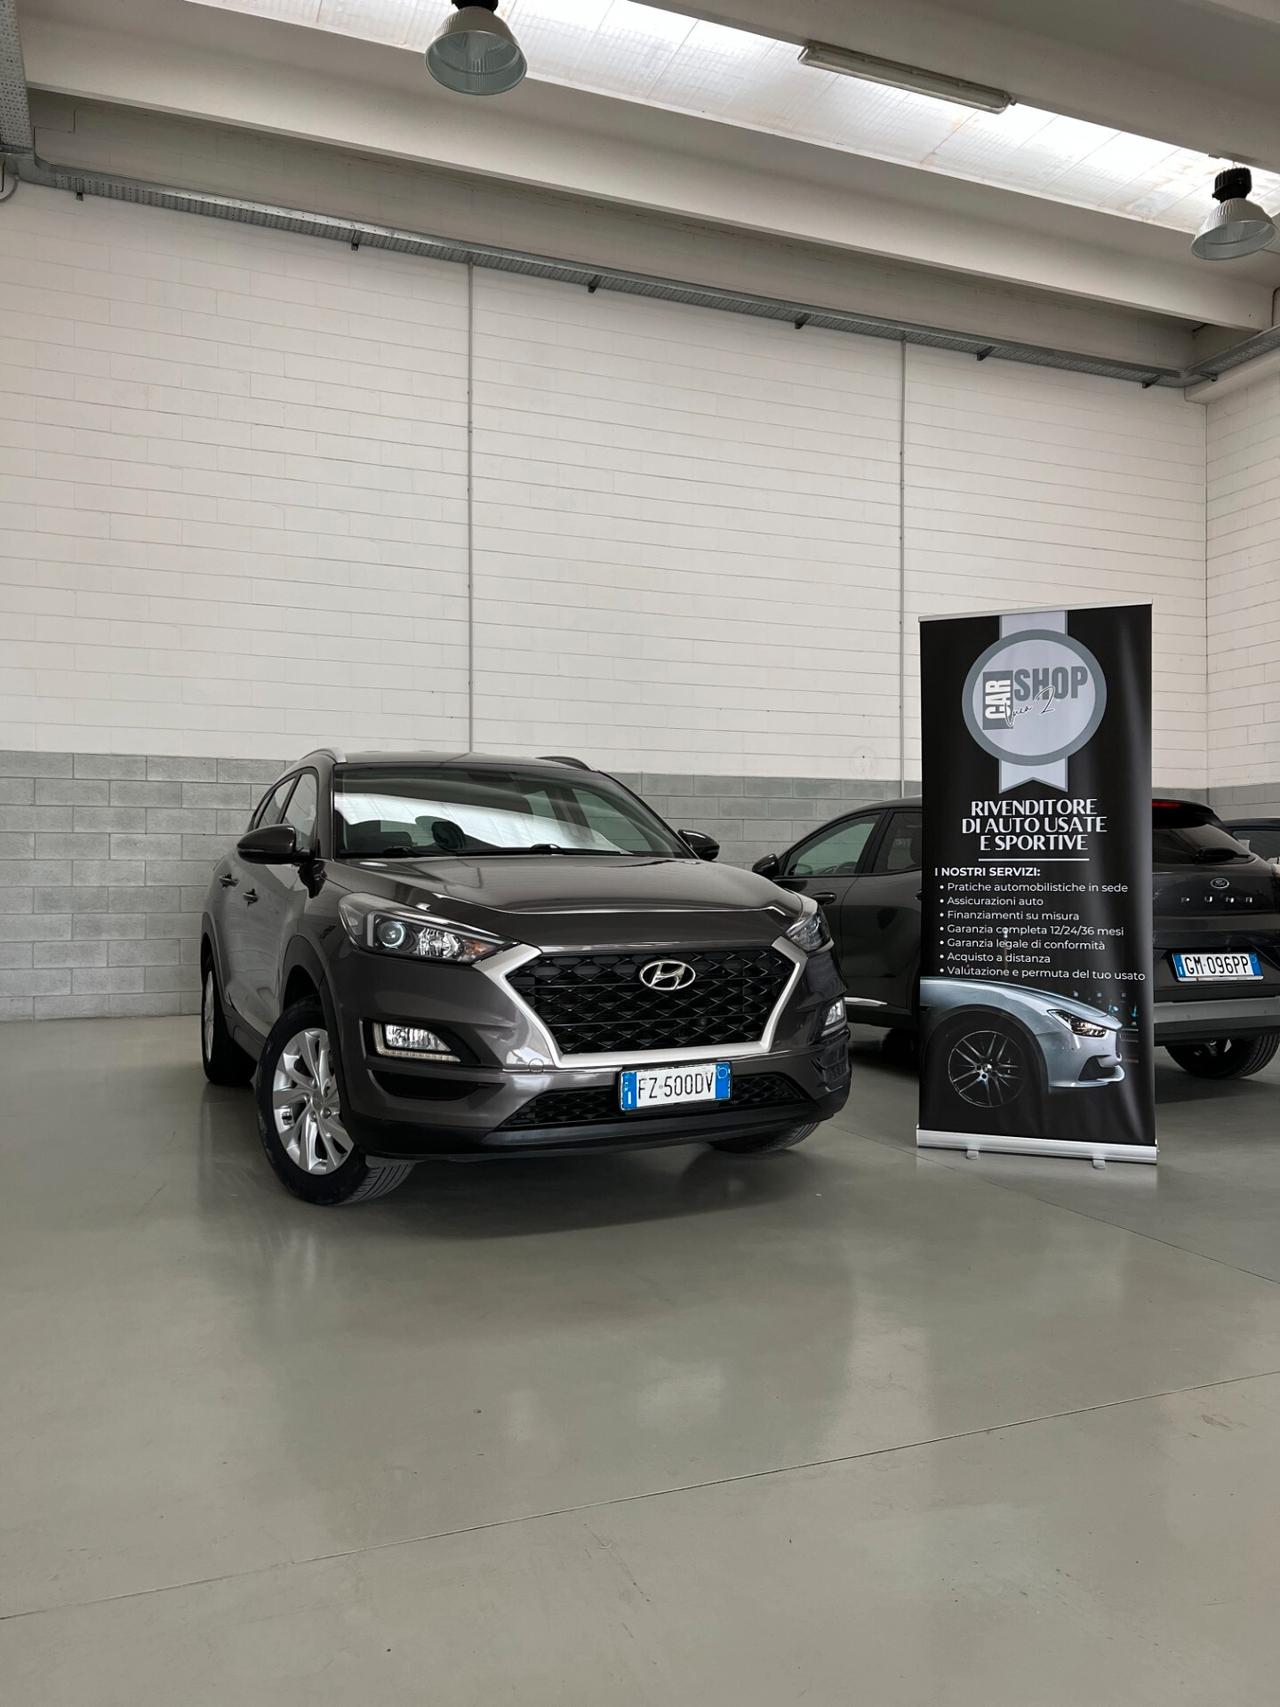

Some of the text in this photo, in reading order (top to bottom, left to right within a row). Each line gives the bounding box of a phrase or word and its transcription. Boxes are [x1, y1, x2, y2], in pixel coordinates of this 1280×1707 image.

[1013, 666, 1088, 701] SHOP
[984, 679, 1011, 720] CAR
[971, 799, 1098, 816] RIVENDITORE
[962, 816, 1108, 834] DI AUTO USATE
[980, 834, 1089, 851] E SPORTIVE
[941, 867, 986, 877] NOSTRI
[989, 867, 1041, 877] SERVIZI:
[947, 882, 1129, 893] Pratiche automobilistiche in sede
[947, 896, 1044, 906] Assicurazioni auto
[947, 910, 1080, 921] Finanziamenti su misura
[947, 924, 1125, 936] Garanzia completa 12/24/36 mesi
[947, 938, 1106, 951] Garanzia legale di conformità
[947, 952, 1051, 964] Acquisto a distanza
[947, 965, 1146, 981] Valutazione e permuta del tuo usato
